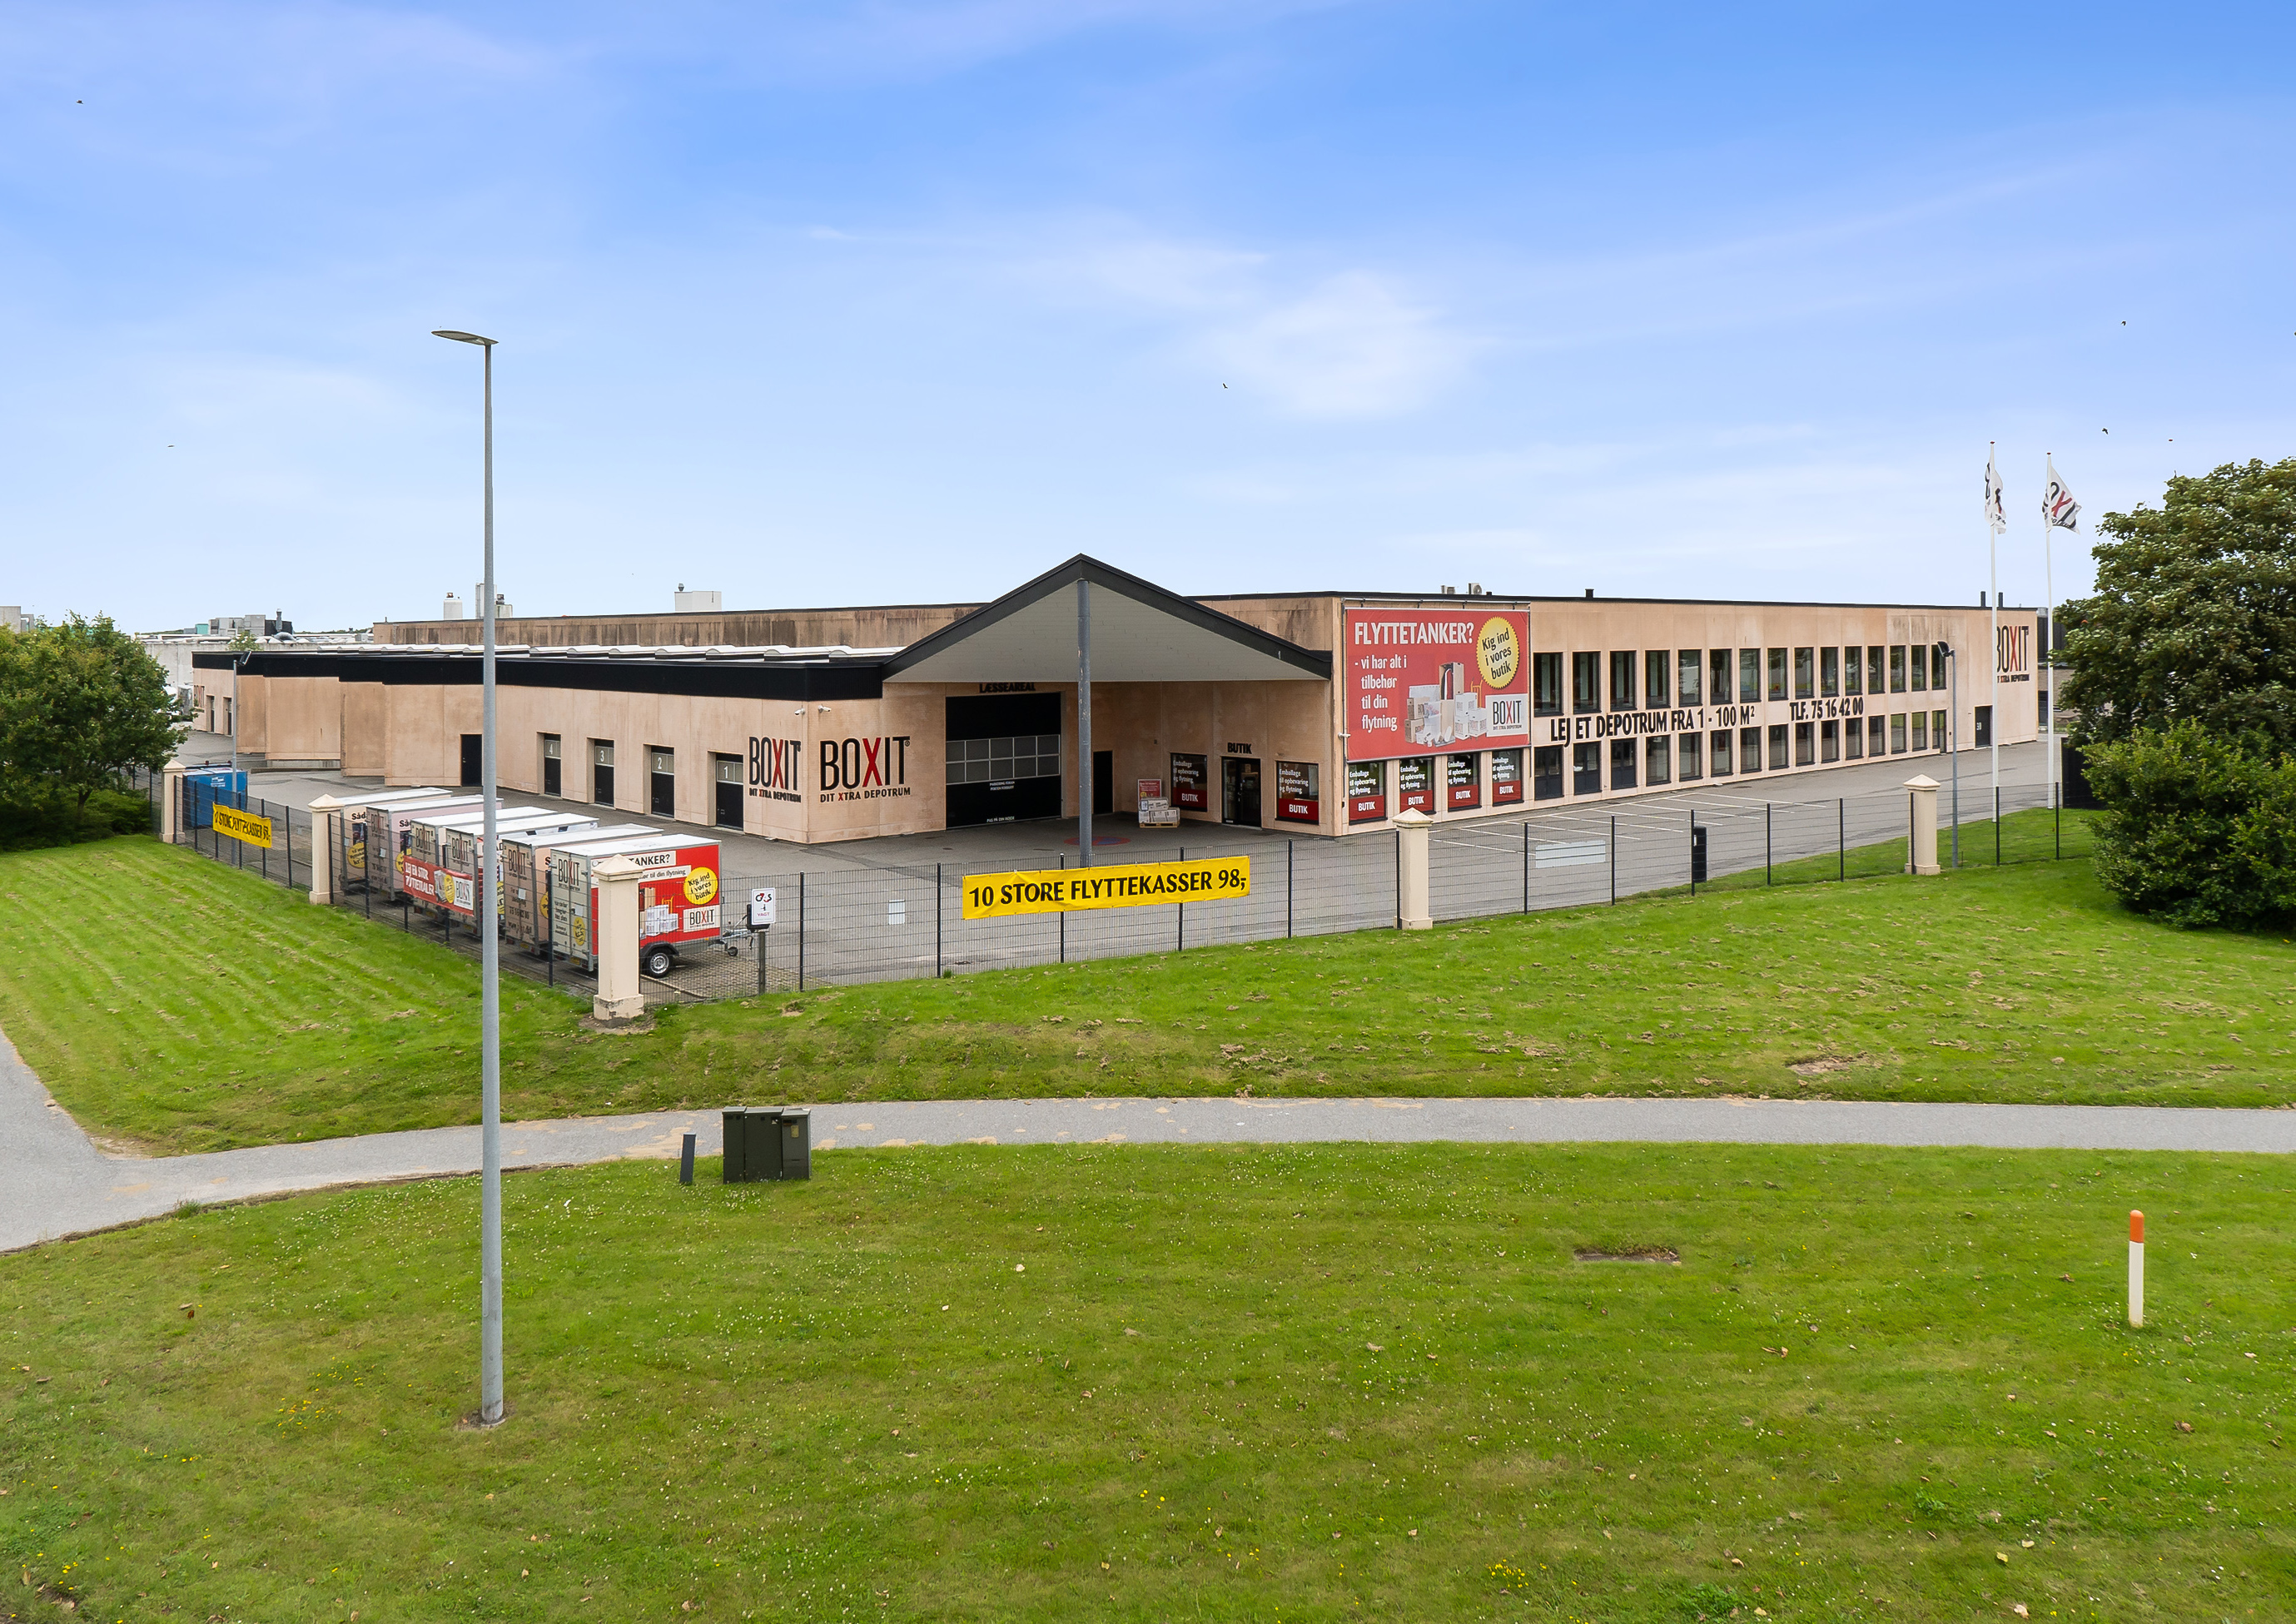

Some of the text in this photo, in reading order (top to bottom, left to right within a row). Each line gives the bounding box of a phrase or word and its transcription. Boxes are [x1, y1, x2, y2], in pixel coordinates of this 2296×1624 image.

[1354, 622, 1474, 644] FLYTTETANKER?
[1482, 628, 1510, 651] Kig ind
[1360, 655, 1369, 669] vi
[1371, 654, 1388, 669] har
[1389, 653, 1402, 668] alt
[1404, 655, 1407, 668] i
[1485, 647, 1512, 666] i vores
[1491, 661, 1512, 680] butik
[979, 682, 1036, 693] LÆSSEAREAL
[1361, 674, 1398, 689] tilbehør
[1361, 693, 1388, 709] til din
[1493, 700, 1521, 725] BOXIT
[1789, 697, 1864, 722] TLF. 75 16 42 00
[1361, 715, 1398, 733] flytning
[1550, 718, 1571, 747] LEJ
[1576, 716, 1592, 740] ET
[1596, 711, 1667, 738] DEPOTRUM
[1671, 709, 1694, 732] FRA
[1697, 708, 1704, 728] 1
[1716, 706, 1737, 728] 100
[549, 743, 553, 754] 4
[1227, 742, 1252, 754] BUTIK
[600, 750, 604, 762] 3
[657, 757, 662, 770] 2
[749, 736, 801, 791] BOXIT
[820, 736, 911, 791] BOXIT
[723, 766, 728, 779] 1
[820, 787, 911, 803] DIT XTRA DEPOTRUM
[1182, 793, 1199, 802] BUTIK
[1455, 790, 1471, 799] BUTIK
[1499, 786, 1513, 795] BUTIK
[1358, 802, 1375, 812] BUTIK
[1408, 796, 1424, 805] BUTIK
[1289, 804, 1308, 814] BUTIK
[700, 872, 710, 881] ind
[694, 882, 711, 891] vores
[968, 868, 1247, 907] 10 STORE FLYTTEKASSER 98,-
[695, 889, 711, 900] butik
[690, 909, 714, 925] BOXIT
